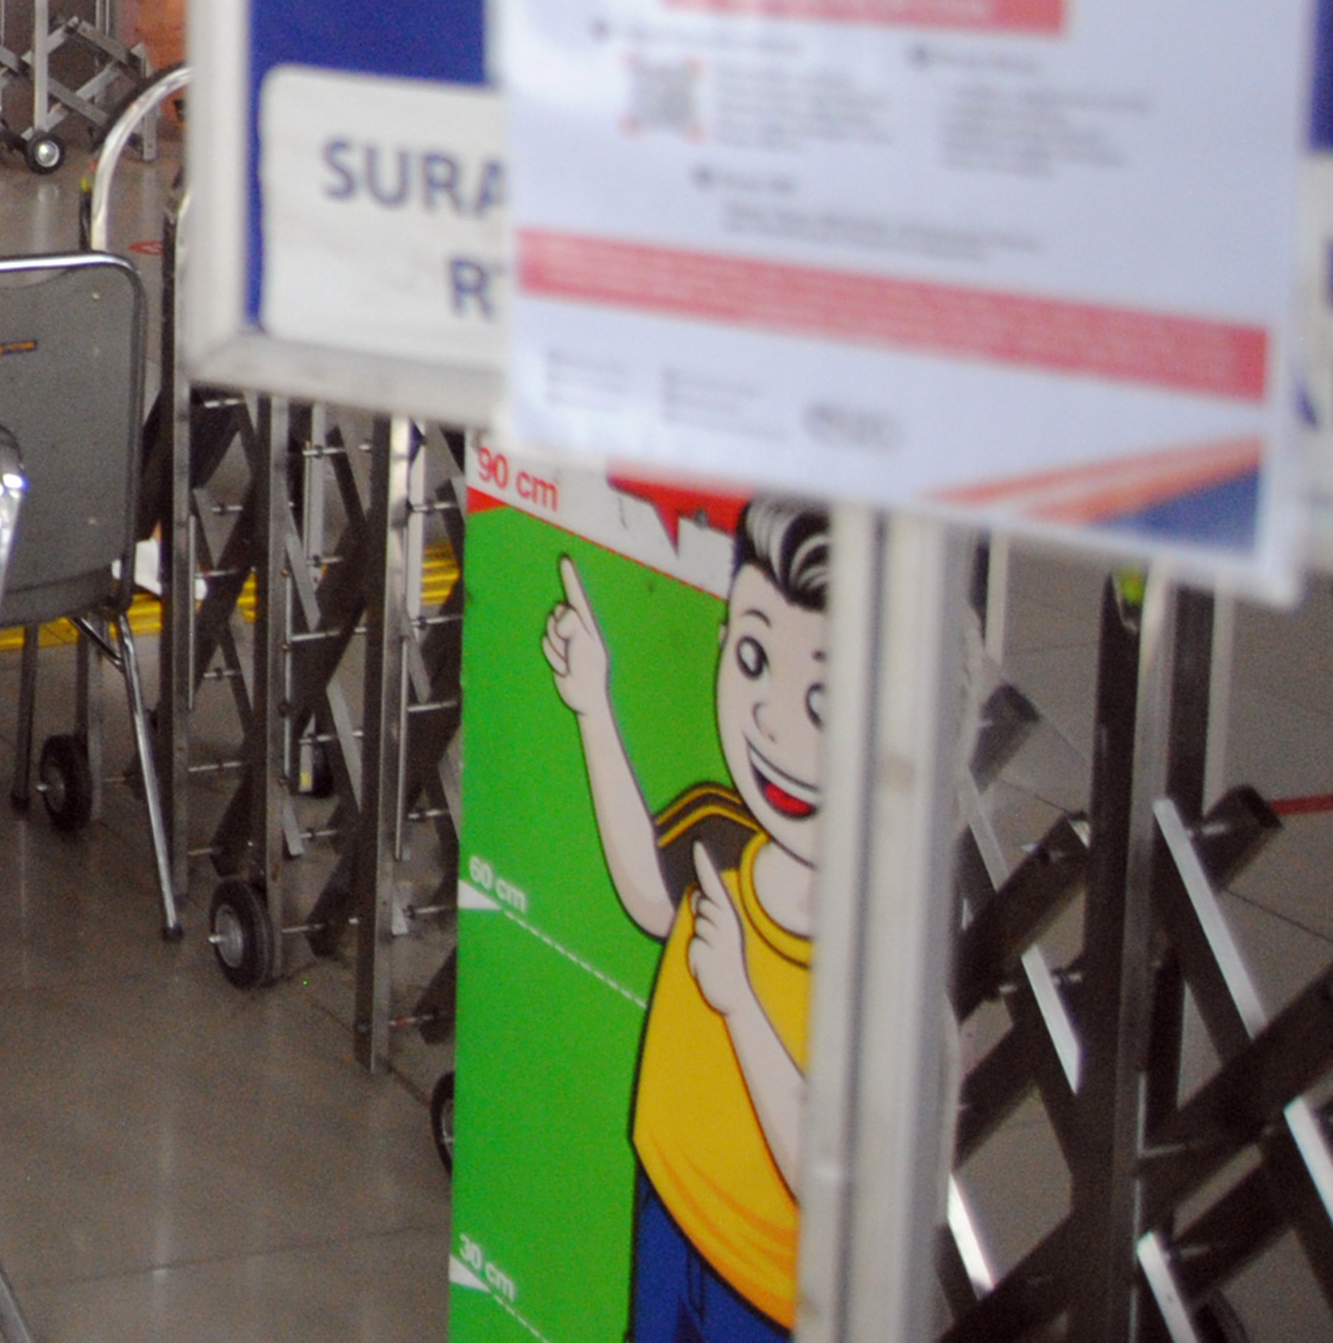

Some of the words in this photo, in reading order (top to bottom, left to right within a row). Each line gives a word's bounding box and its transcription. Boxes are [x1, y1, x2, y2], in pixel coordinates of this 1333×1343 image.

[477, 446, 509, 490] 90
[515, 471, 558, 513] cm
[468, 854, 493, 892] 60
[495, 877, 527, 914] cm
[458, 1233, 483, 1271] 30
[485, 1262, 515, 1304] cm
